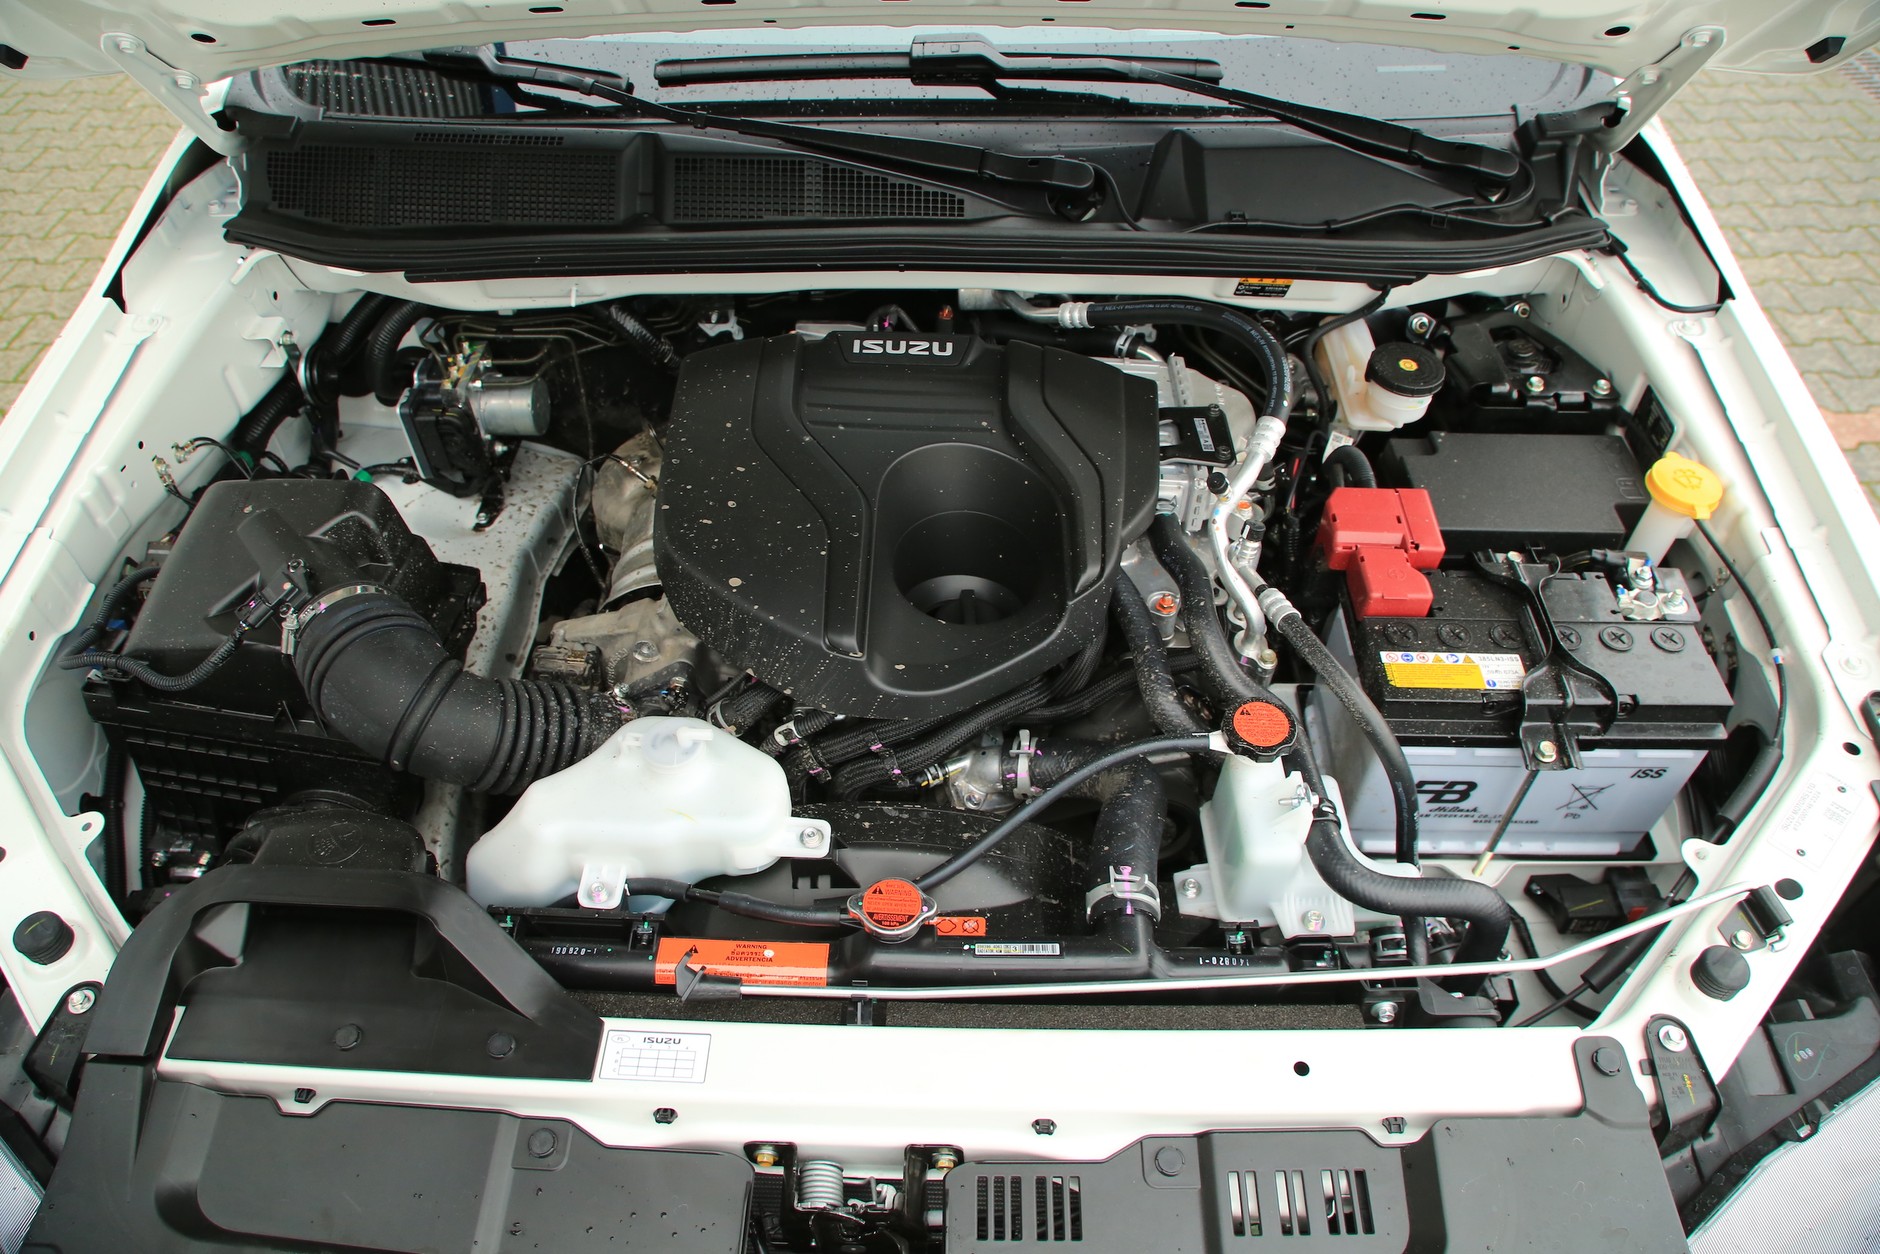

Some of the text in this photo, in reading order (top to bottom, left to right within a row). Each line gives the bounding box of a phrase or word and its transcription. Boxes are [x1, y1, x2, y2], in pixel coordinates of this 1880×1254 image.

[853, 339, 953, 356] ISUZU
[1630, 768, 1667, 779] ISS
[885, 888, 912, 897] WARNING
[725, 955, 773, 963] ADVERTENCIA
[643, 1036, 682, 1045] ISUZU
